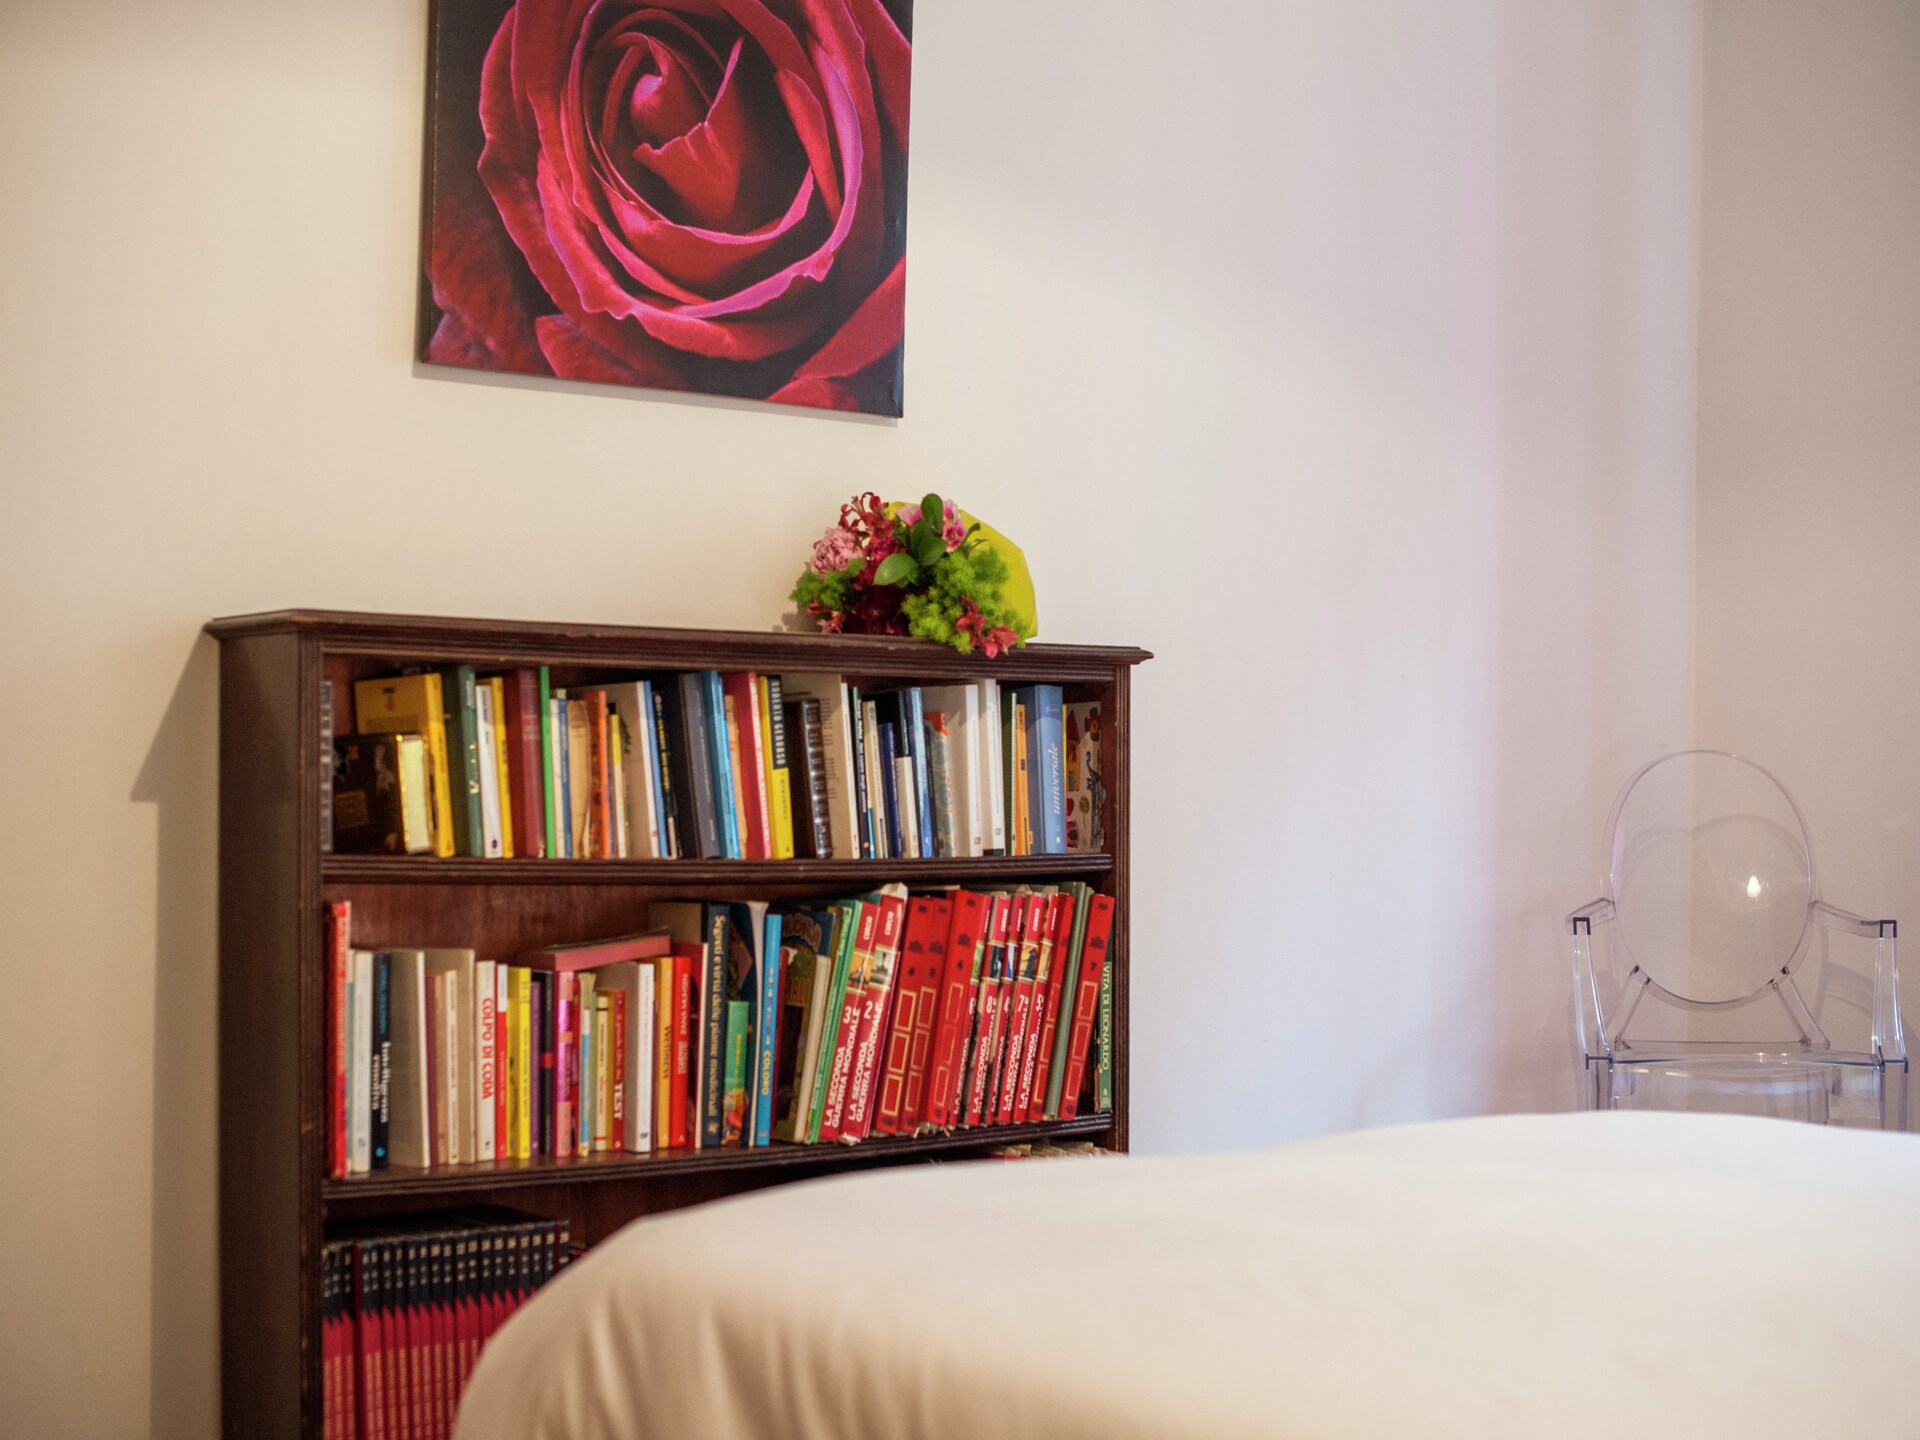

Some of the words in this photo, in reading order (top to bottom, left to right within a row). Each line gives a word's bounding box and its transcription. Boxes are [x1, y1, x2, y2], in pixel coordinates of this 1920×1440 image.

[771, 680, 782, 721] ROBERTO
[774, 723, 786, 765] GERVASO
[1047, 742, 1061, 815] universale
[713, 914, 726, 954] Segreti
[713, 955, 722, 964] e
[1102, 965, 1110, 991] VITA
[482, 997, 493, 1041] COLPO
[711, 993, 722, 1021] delle
[843, 1006, 852, 1024] 3
[864, 1001, 873, 1019] 2
[986, 995, 993, 1014] 8
[1017, 994, 1025, 1012] 7
[1102, 994, 1110, 1005] DI
[482, 1045, 493, 1059] DI
[663, 1025, 672, 1080] Wellness
[708, 1022, 719, 1058] piante
[1102, 1009, 1110, 1071] LEONARDO
[828, 1046, 845, 1105] SECONDA
[832, 1075, 848, 1128] GUERRA
[842, 1008, 860, 1073] MONDIALE
[851, 1041, 868, 1100] SECONDA
[856, 1070, 871, 1123] GUERRA
[865, 1001, 883, 1068] MONDIALE
[957, 1038, 970, 1094] SECONDA
[972, 1097, 980, 1114] LA
[976, 1036, 988, 1093] SECONDA
[1006, 1034, 1019, 1091] SECONDA
[1022, 1033, 1036, 1089] SECONDA
[482, 1062, 493, 1100] CODA
[708, 1058, 719, 1117] medicinali
[613, 1083, 623, 1120] TEST
[824, 1109, 834, 1127] LA
[848, 1102, 857, 1121] LA
[1003, 1094, 1011, 1111] LA
[1019, 1093, 1026, 1109] LA
